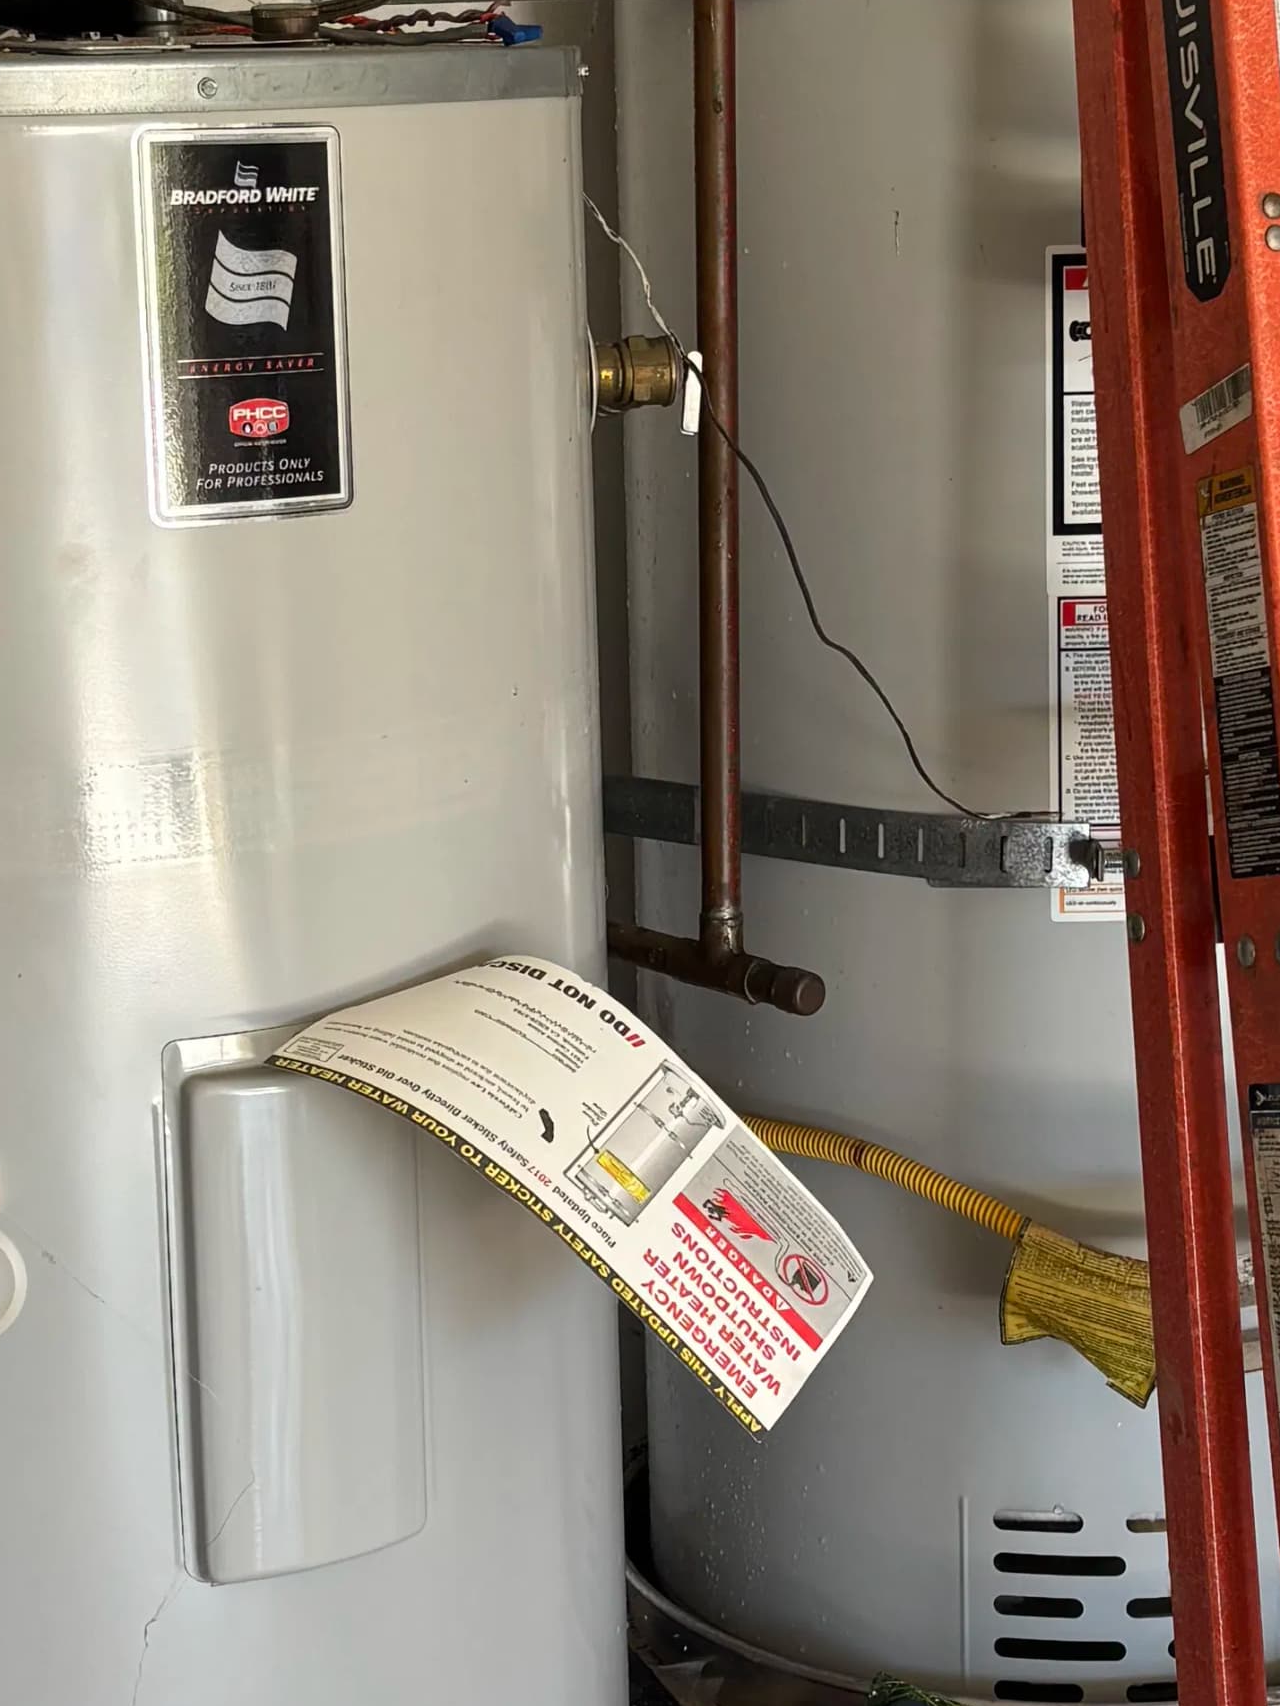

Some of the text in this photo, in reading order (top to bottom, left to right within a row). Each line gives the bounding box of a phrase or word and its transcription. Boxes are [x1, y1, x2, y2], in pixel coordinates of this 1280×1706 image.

[170, 187, 319, 205] BRADFORD WHITE
[188, 357, 316, 375] ENERGY SAVER
[233, 403, 287, 421] PHCC
[196, 470, 324, 490] FOR PROFESSIONALS
[209, 460, 274, 475] PRODUCTS
[548, 975, 631, 1035] DO NOT
[274, 1050, 346, 1091] HEATER
[335, 1050, 375, 1076] Sticker
[374, 1067, 395, 1084] Old
[344, 1077, 411, 1115] WATER
[394, 1074, 421, 1094] Over
[417, 1085, 465, 1117] Directly
[406, 1108, 461, 1146] YOUR
[459, 1109, 497, 1146] Sticker
[458, 1141, 484, 1167] TO
[495, 1137, 530, 1170] Safety
[483, 1160, 553, 1225] STICKER
[525, 1163, 552, 1189] 2017
[549, 1184, 593, 1225] Updated
[553, 1219, 613, 1278] SAFETY
[701, 1224, 775, 1298] DANGER
[665, 1220, 805, 1360] INSTRUCTIONS
[669, 1250, 779, 1361] SHUTDOWN
[607, 1275, 679, 1347] UPDATED
[639, 1246, 784, 1395] WATER HEATER
[638, 1275, 760, 1397] EMERGENCY
[677, 1345, 717, 1385] THIS
[715, 1384, 761, 1432] APPLY
